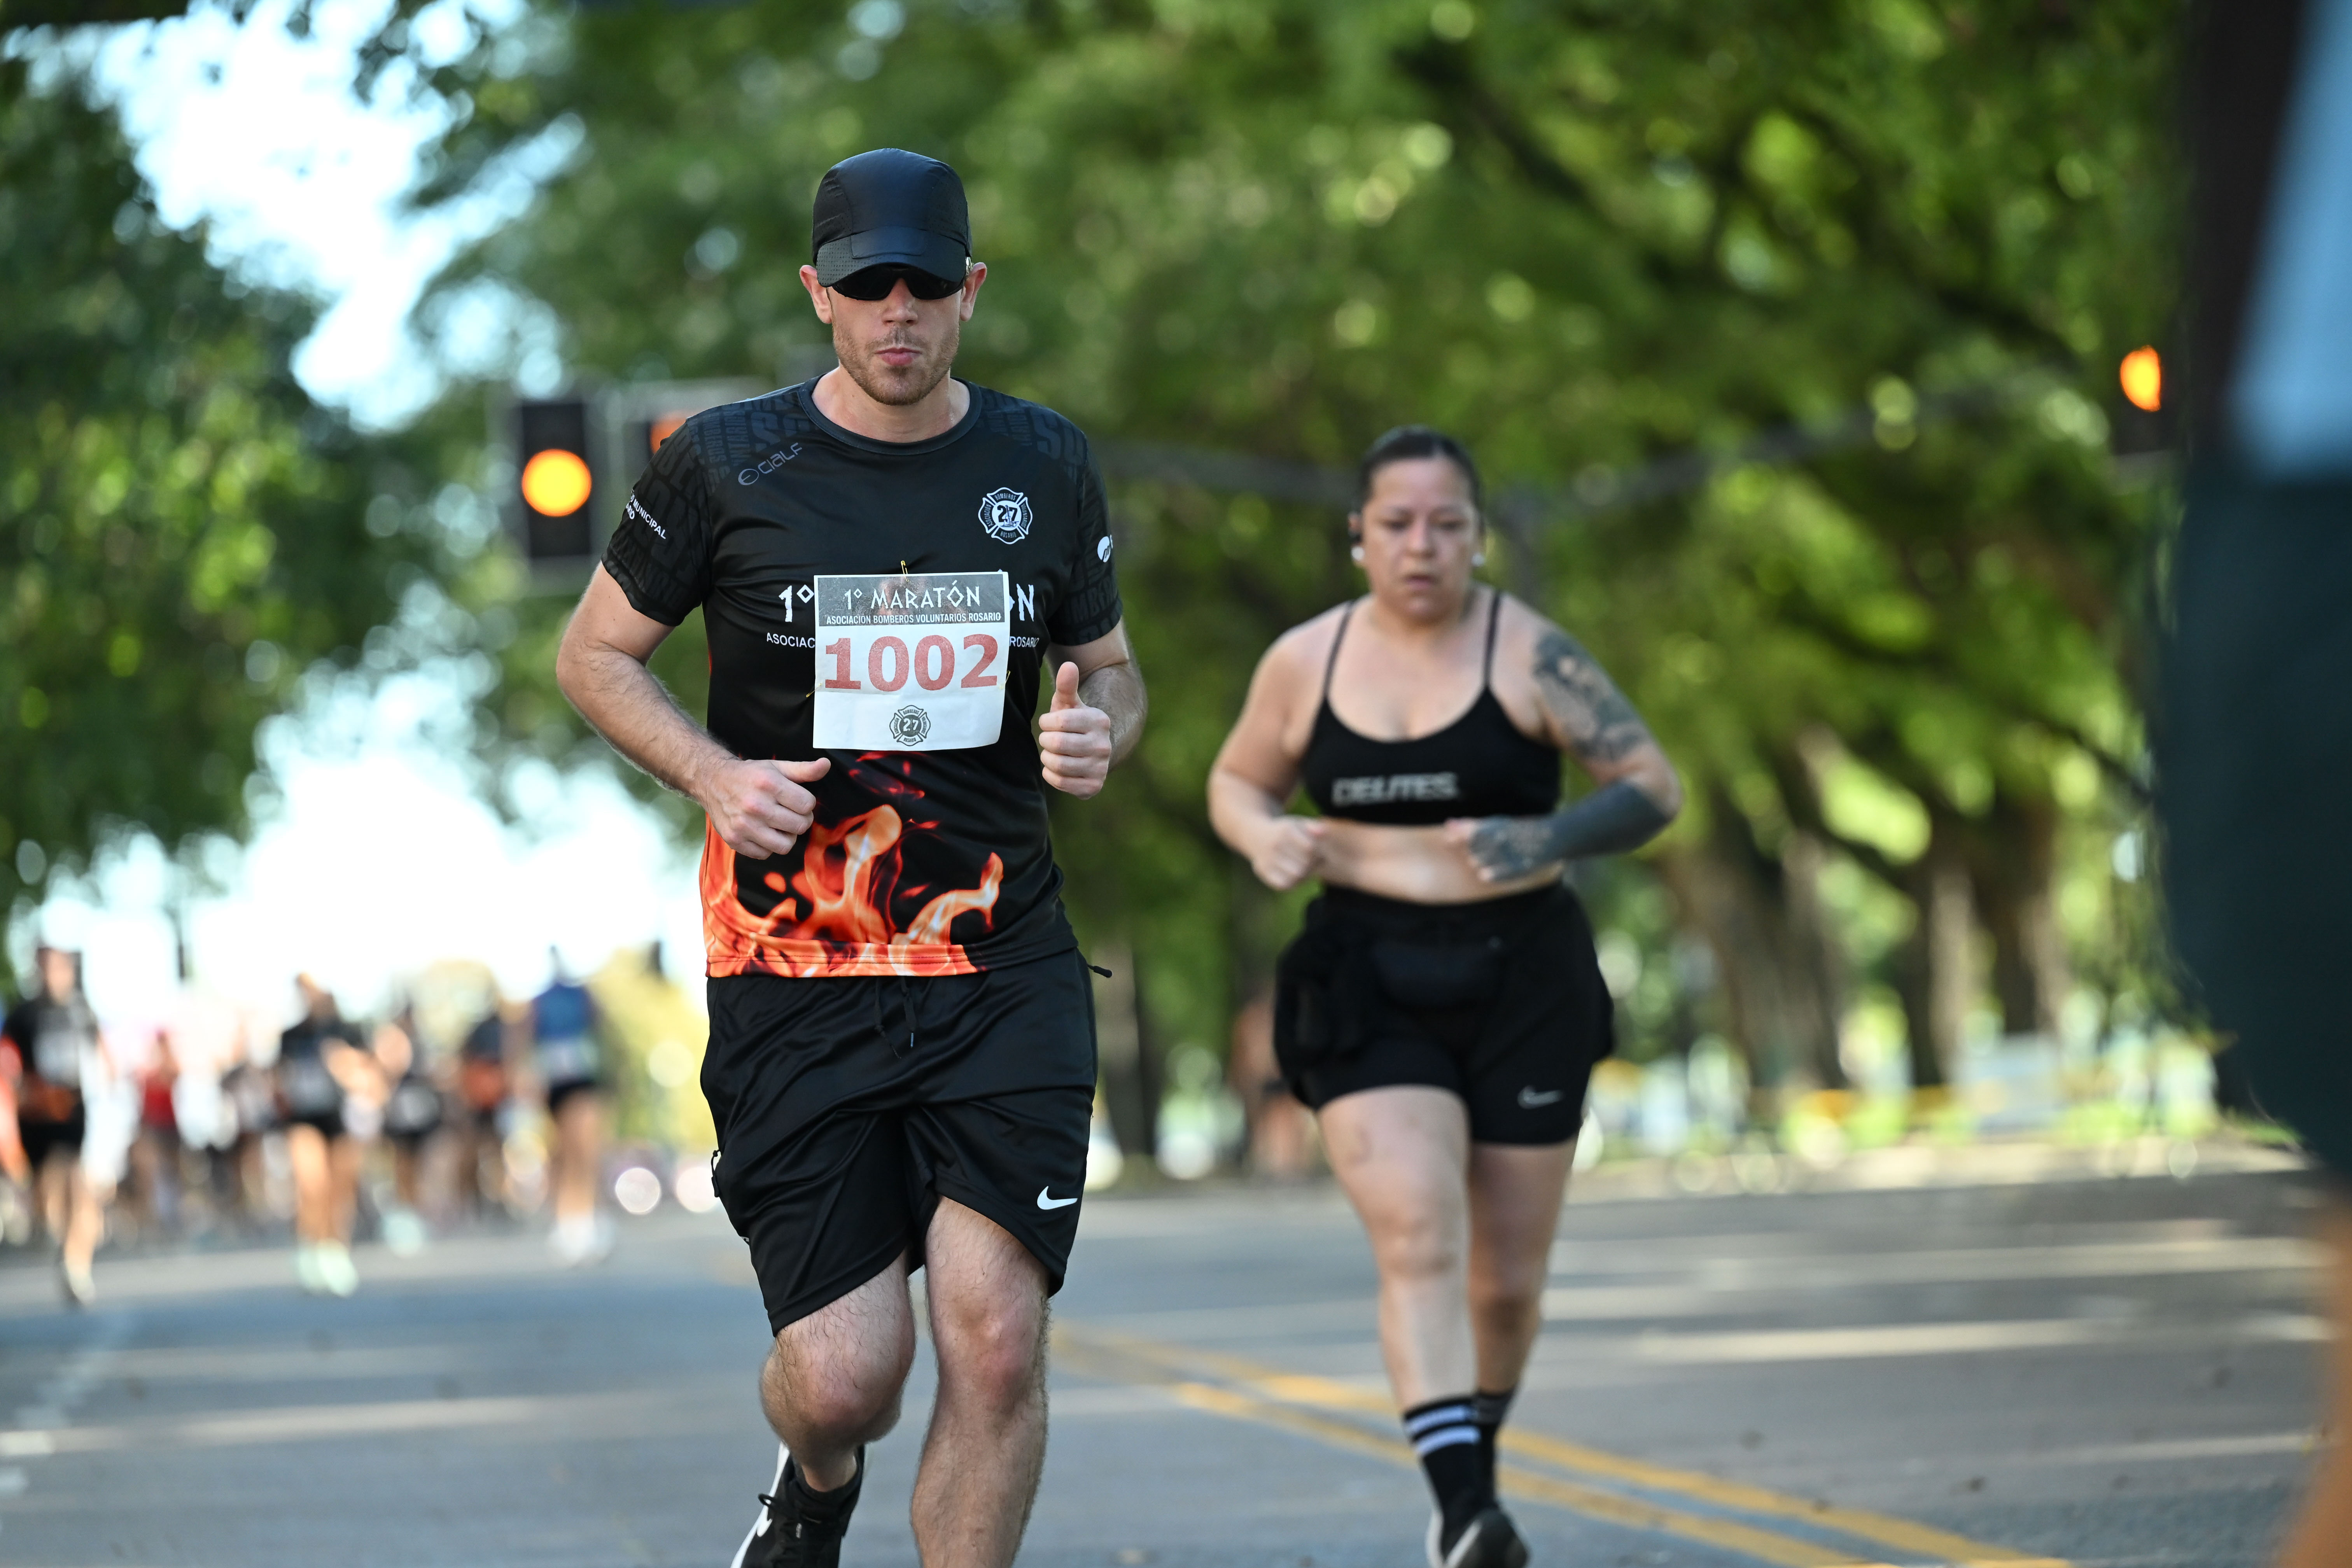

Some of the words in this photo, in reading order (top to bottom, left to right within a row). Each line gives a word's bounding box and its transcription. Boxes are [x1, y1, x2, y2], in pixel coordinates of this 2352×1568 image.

[994, 493, 1017, 501] BOMBEROS
[625, 501, 635, 520] ARIO
[633, 498, 666, 539] MUNICIPAL
[997, 505, 1018, 523] 27
[870, 580, 980, 609] MARATÓN
[873, 614, 914, 623] BOMBEROS
[916, 613, 967, 623] VOLUNTARIOS
[969, 612, 1002, 621] ROSARIO
[766, 632, 815, 648] ASOCIAC
[1010, 636, 1040, 648] ROSARIO
[825, 634, 998, 692] 1002
[903, 718, 919, 732] 27
